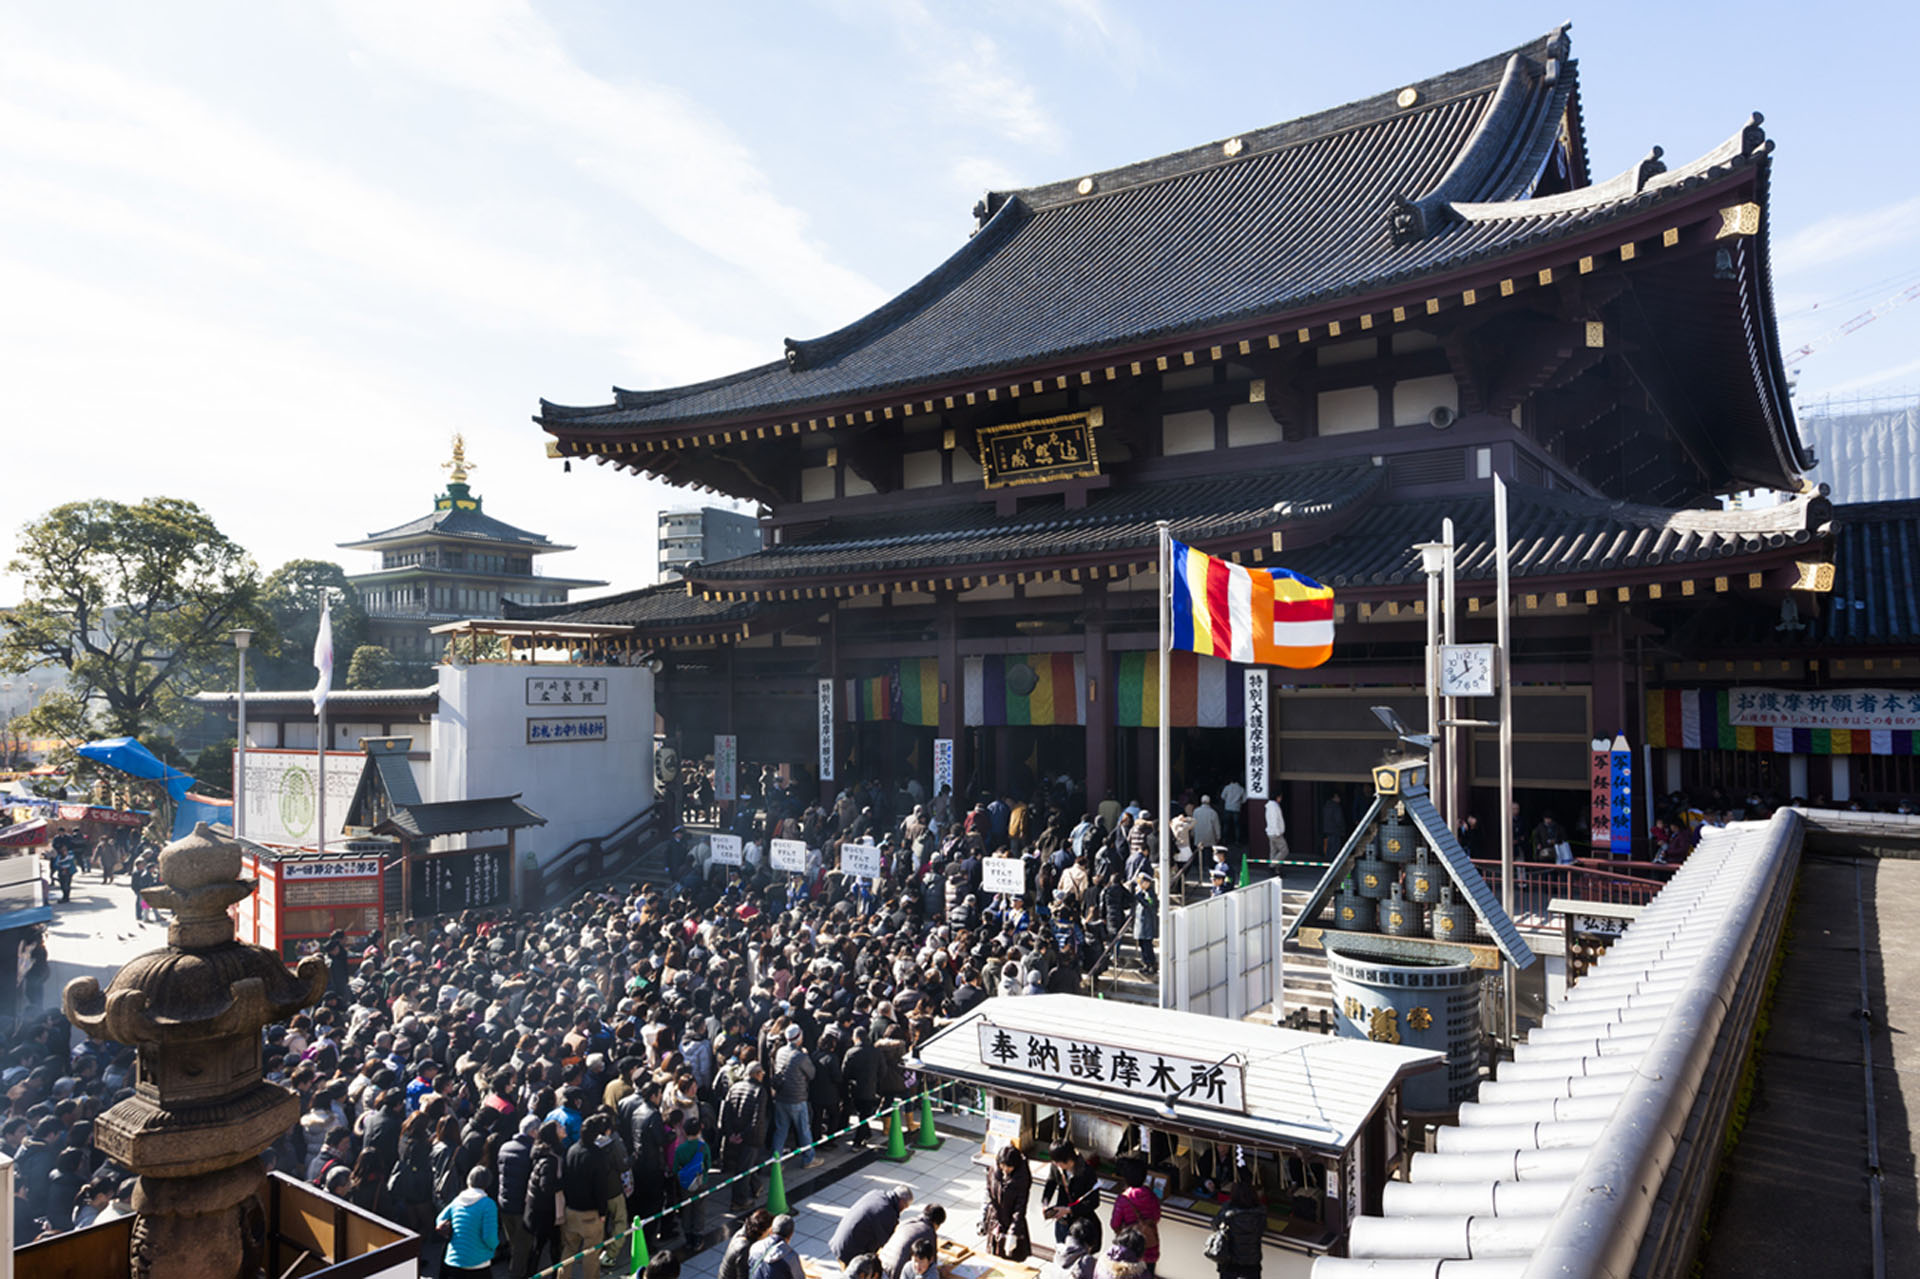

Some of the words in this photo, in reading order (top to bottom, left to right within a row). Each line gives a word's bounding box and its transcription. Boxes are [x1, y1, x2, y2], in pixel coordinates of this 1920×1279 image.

[990, 1029, 1228, 1105] 奉納護摩木所
